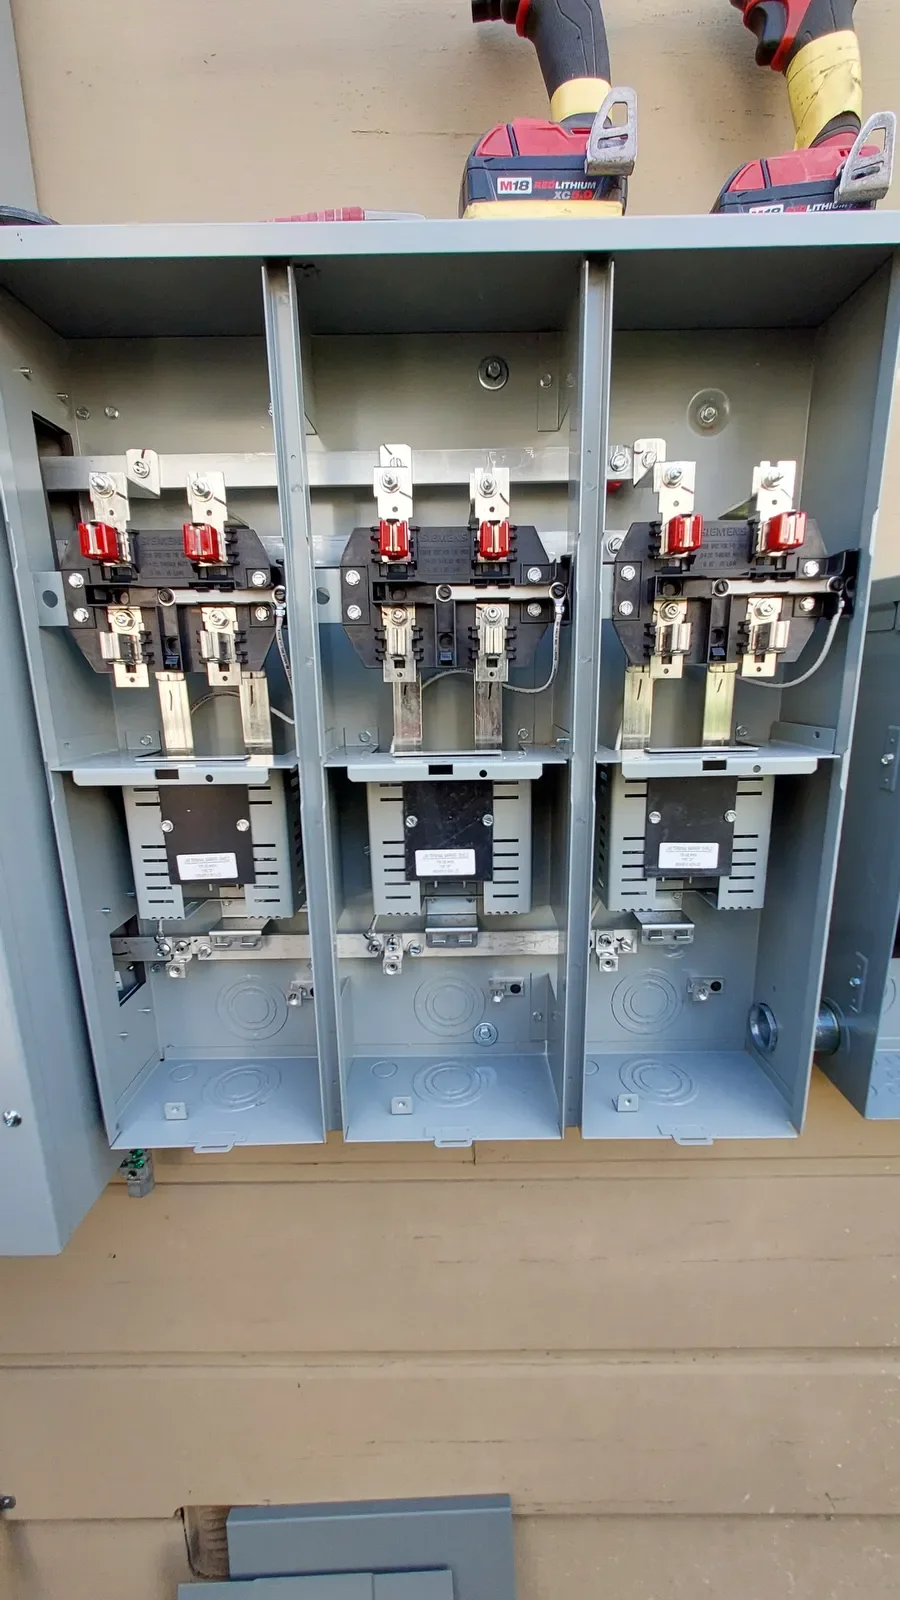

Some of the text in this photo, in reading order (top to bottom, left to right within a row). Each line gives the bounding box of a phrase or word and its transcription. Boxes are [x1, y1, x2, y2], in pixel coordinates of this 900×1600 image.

[500, 180, 597, 191] M18 REDLITHIUM
[419, 532, 469, 543] SIEMENS
